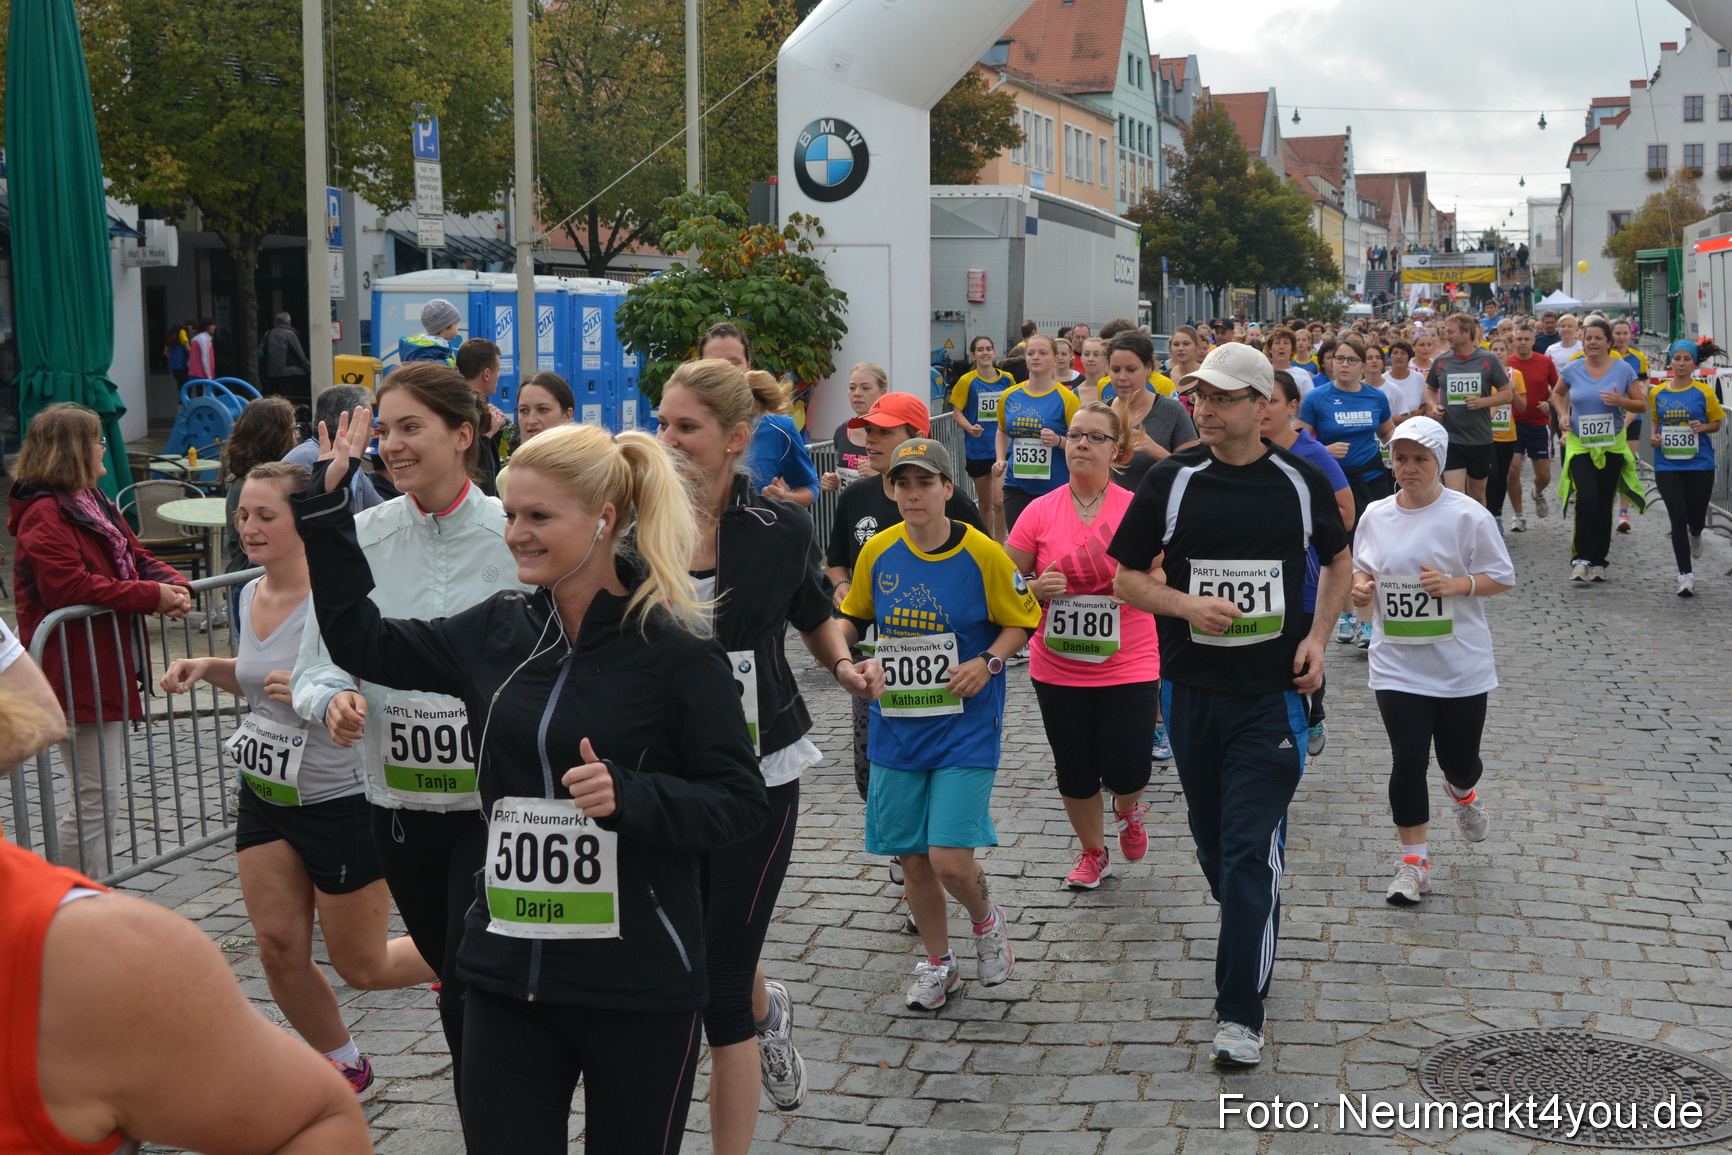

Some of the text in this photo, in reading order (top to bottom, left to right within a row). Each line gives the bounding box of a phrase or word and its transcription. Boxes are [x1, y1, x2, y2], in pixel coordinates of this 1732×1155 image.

[799, 120, 863, 148] BMW
[363, 271, 370, 290] 3
[1432, 272, 1465, 280] START
[496, 309, 513, 336] DIXI
[538, 309, 555, 334] DIXI
[583, 311, 602, 335] DIXI
[1450, 381, 1478, 393] 5019
[1334, 411, 1372, 420] HUBER
[1582, 422, 1610, 435] 5027
[1665, 434, 1695, 446] 5538
[1016, 448, 1047, 464] 5533
[1192, 568, 1267, 577] PARTL Neumarkt
[1380, 581, 1424, 590] PARTL Neum
[1072, 601, 1107, 609] Neumarkt
[1386, 592, 1443, 618] 5521
[1053, 610, 1113, 638] 5180
[901, 643, 942, 653] Neumarkt
[1062, 641, 1100, 653] Daniela
[881, 654, 951, 687] 5082
[891, 693, 944, 706] Katharina
[414, 707, 467, 719] Neumark
[390, 722, 475, 764] 5090
[231, 734, 291, 781] 5051
[415, 774, 457, 793] Tanja
[523, 811, 589, 826] Neumarkt
[495, 831, 602, 885] 5068
[516, 897, 564, 923] Darja
